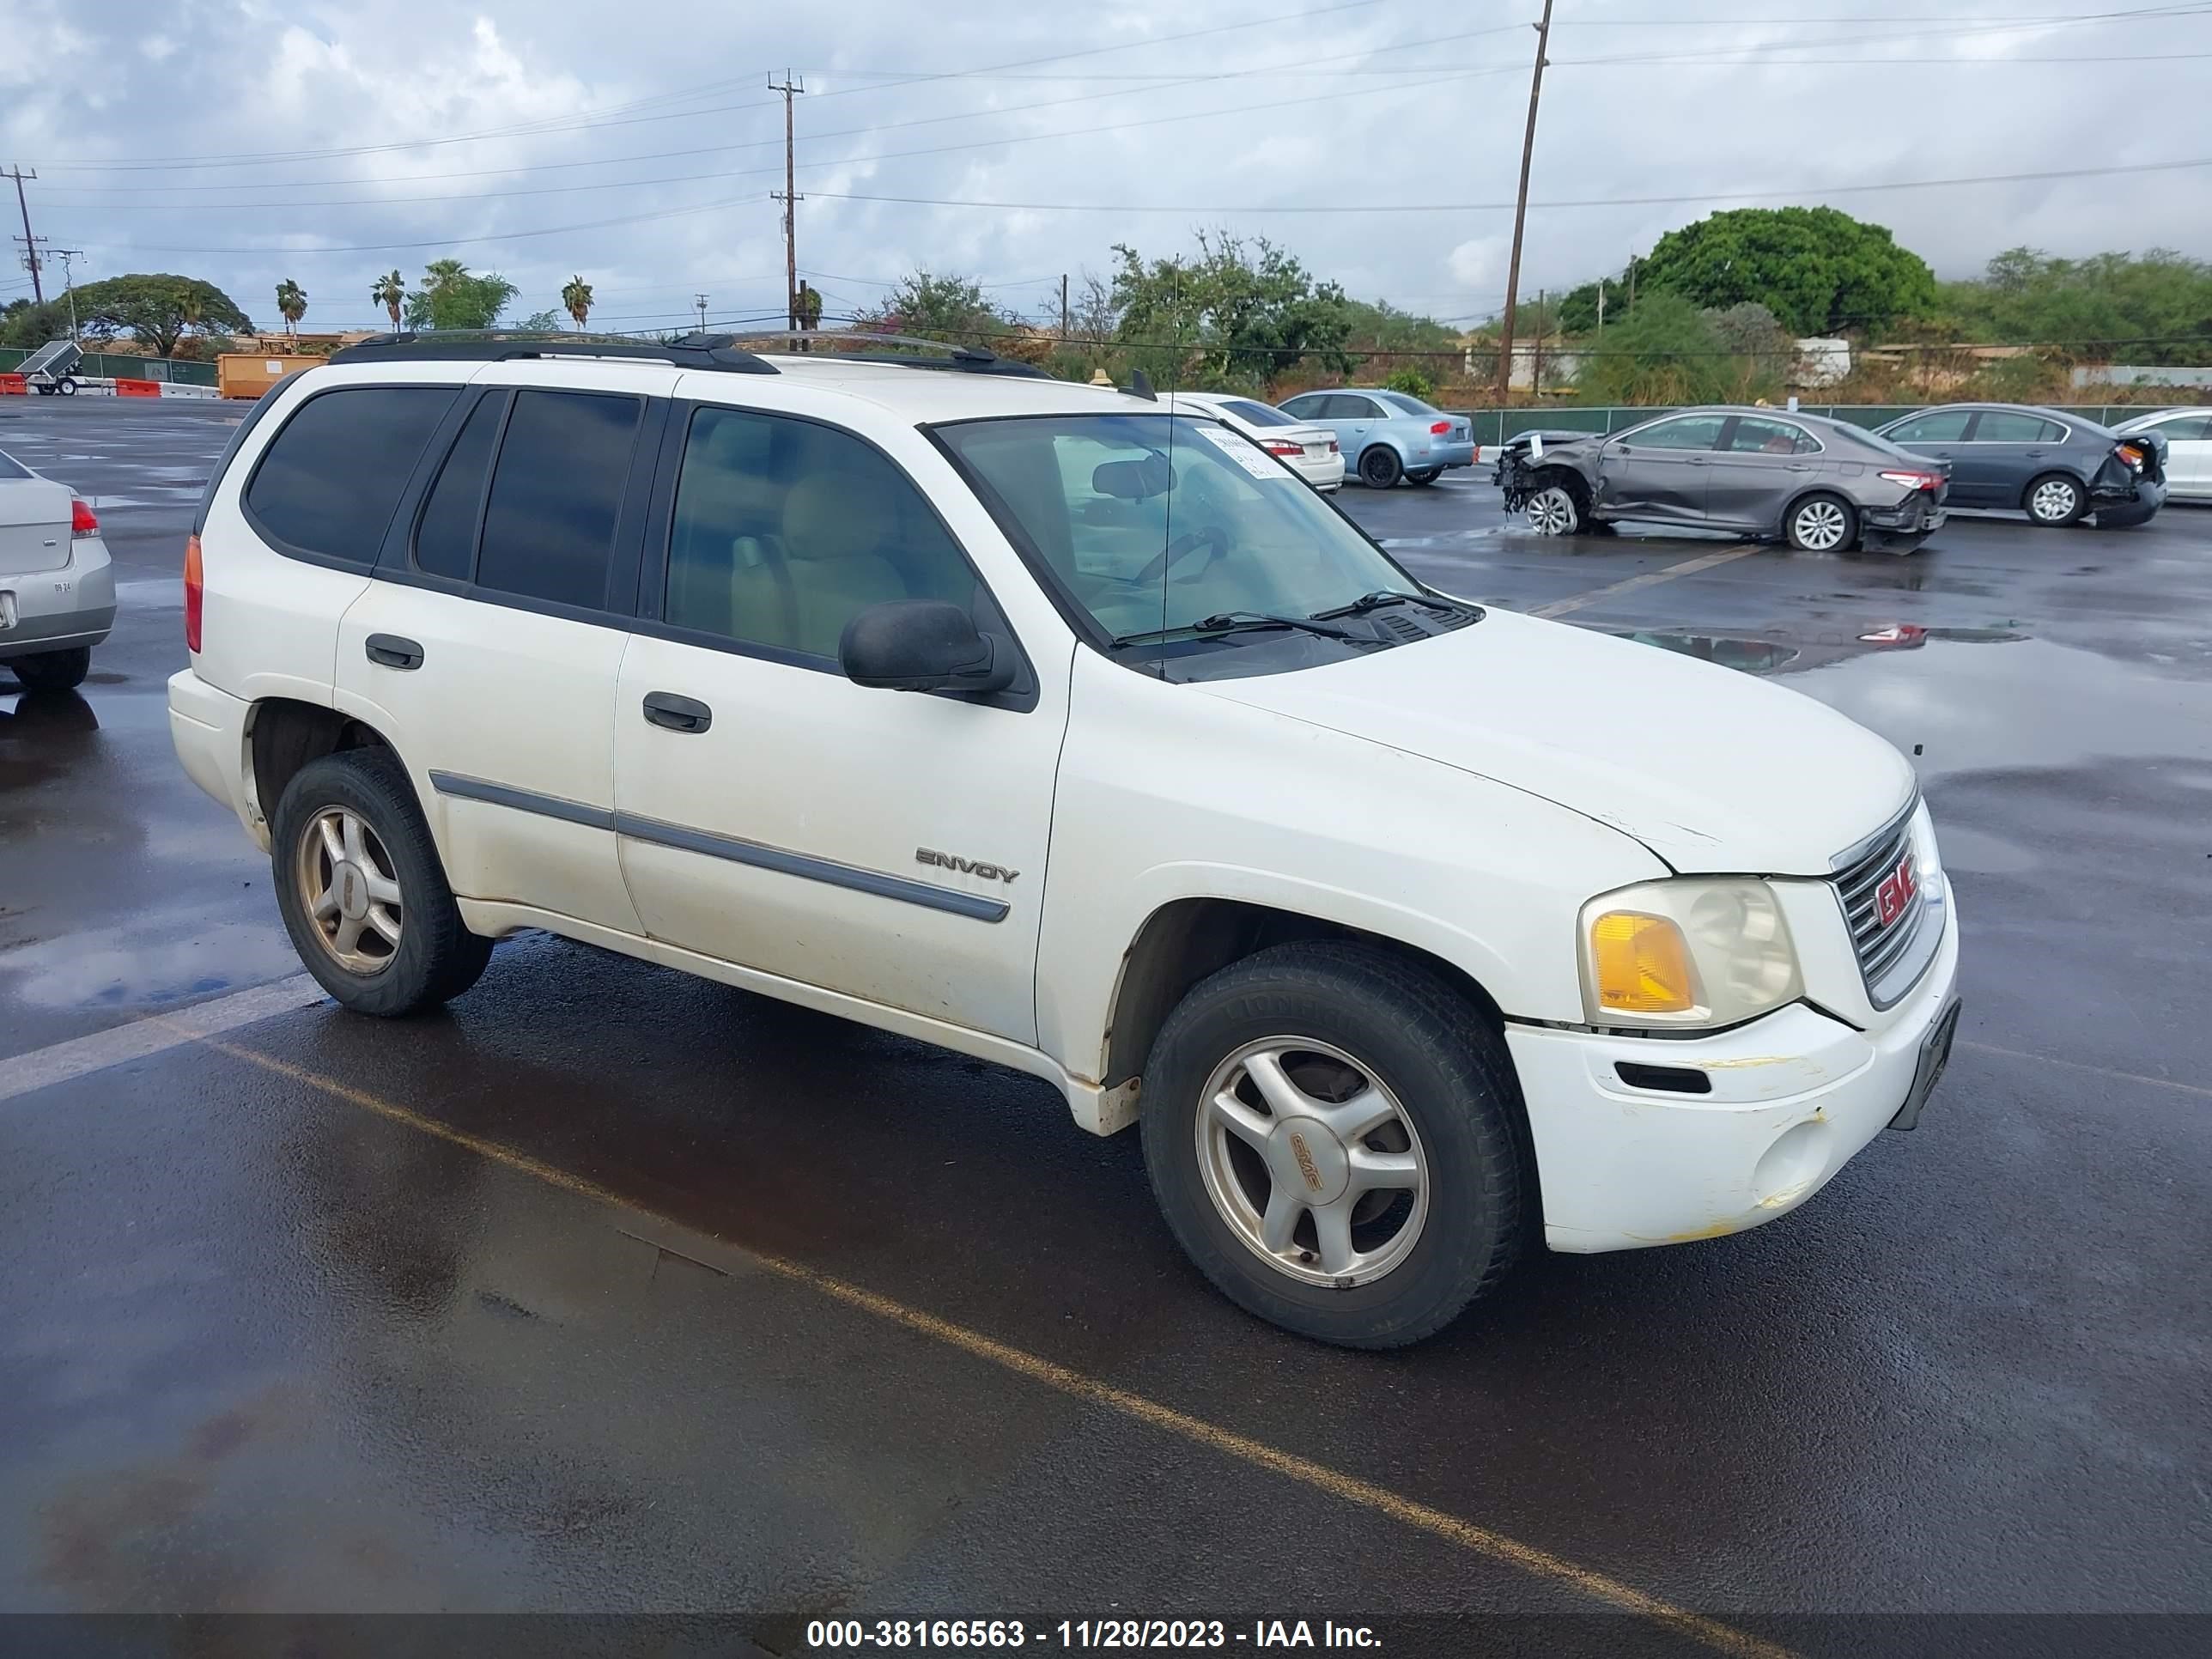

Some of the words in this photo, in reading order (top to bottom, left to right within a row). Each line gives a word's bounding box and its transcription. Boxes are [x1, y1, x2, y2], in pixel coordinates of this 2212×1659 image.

[915, 846, 1021, 884] ENVOY
[1875, 853, 1918, 928] GMC
[1291, 1133, 1324, 1191] GMC
